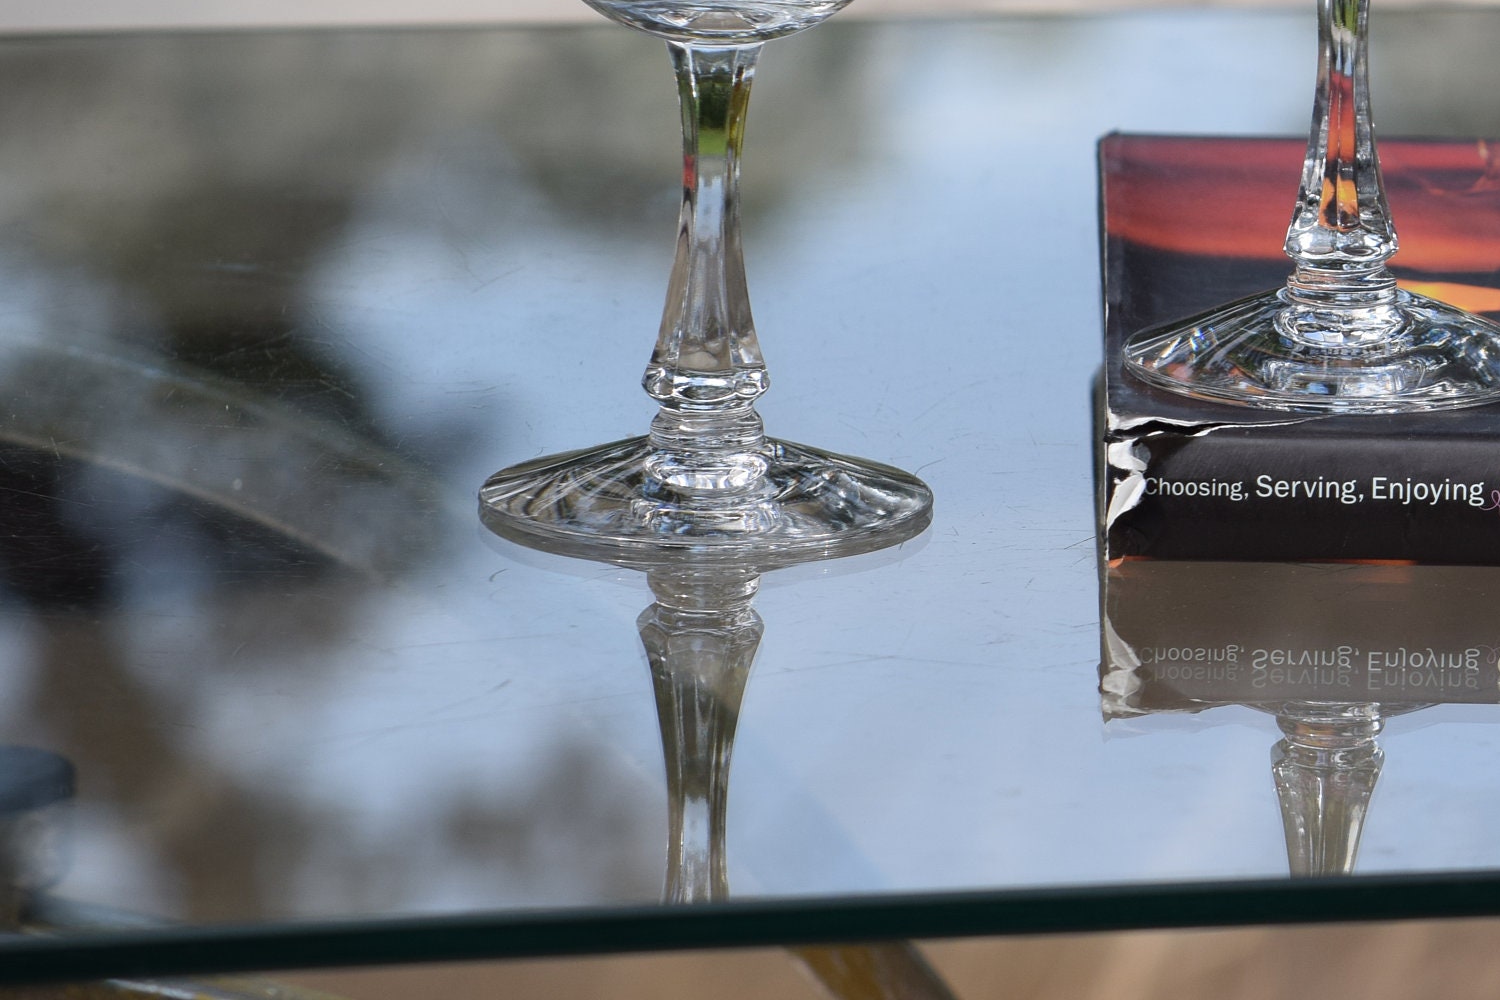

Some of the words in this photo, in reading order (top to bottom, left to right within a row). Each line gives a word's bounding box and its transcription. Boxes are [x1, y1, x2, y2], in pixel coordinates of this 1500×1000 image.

[1143, 477, 1249, 500] Choosing,
[1255, 474, 1364, 505] Serving,
[1371, 476, 1485, 507] Enjoying
